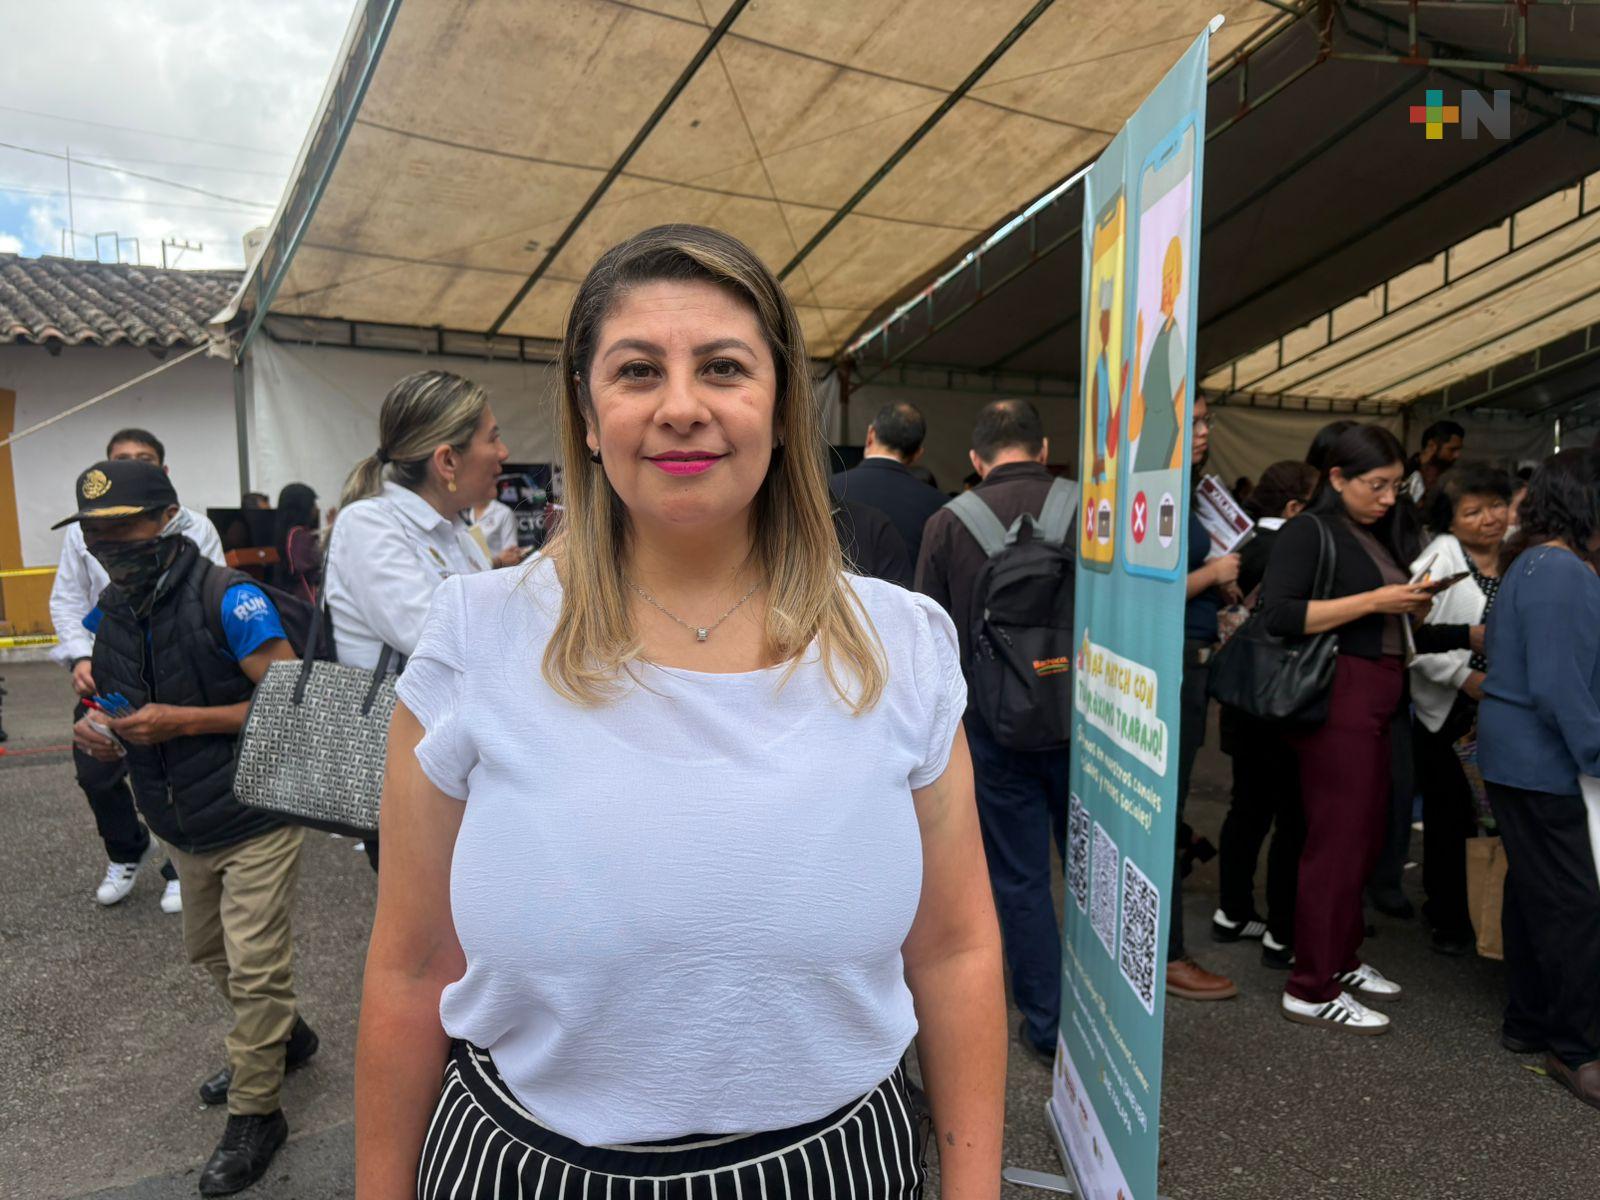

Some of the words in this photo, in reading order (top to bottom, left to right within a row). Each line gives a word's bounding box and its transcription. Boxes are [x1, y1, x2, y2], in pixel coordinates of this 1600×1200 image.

[233, 596, 268, 624] RUN
[1104, 661, 1132, 695] MATCH
[1134, 672, 1155, 710] CON
[1115, 707, 1164, 762] TRABAJO!
